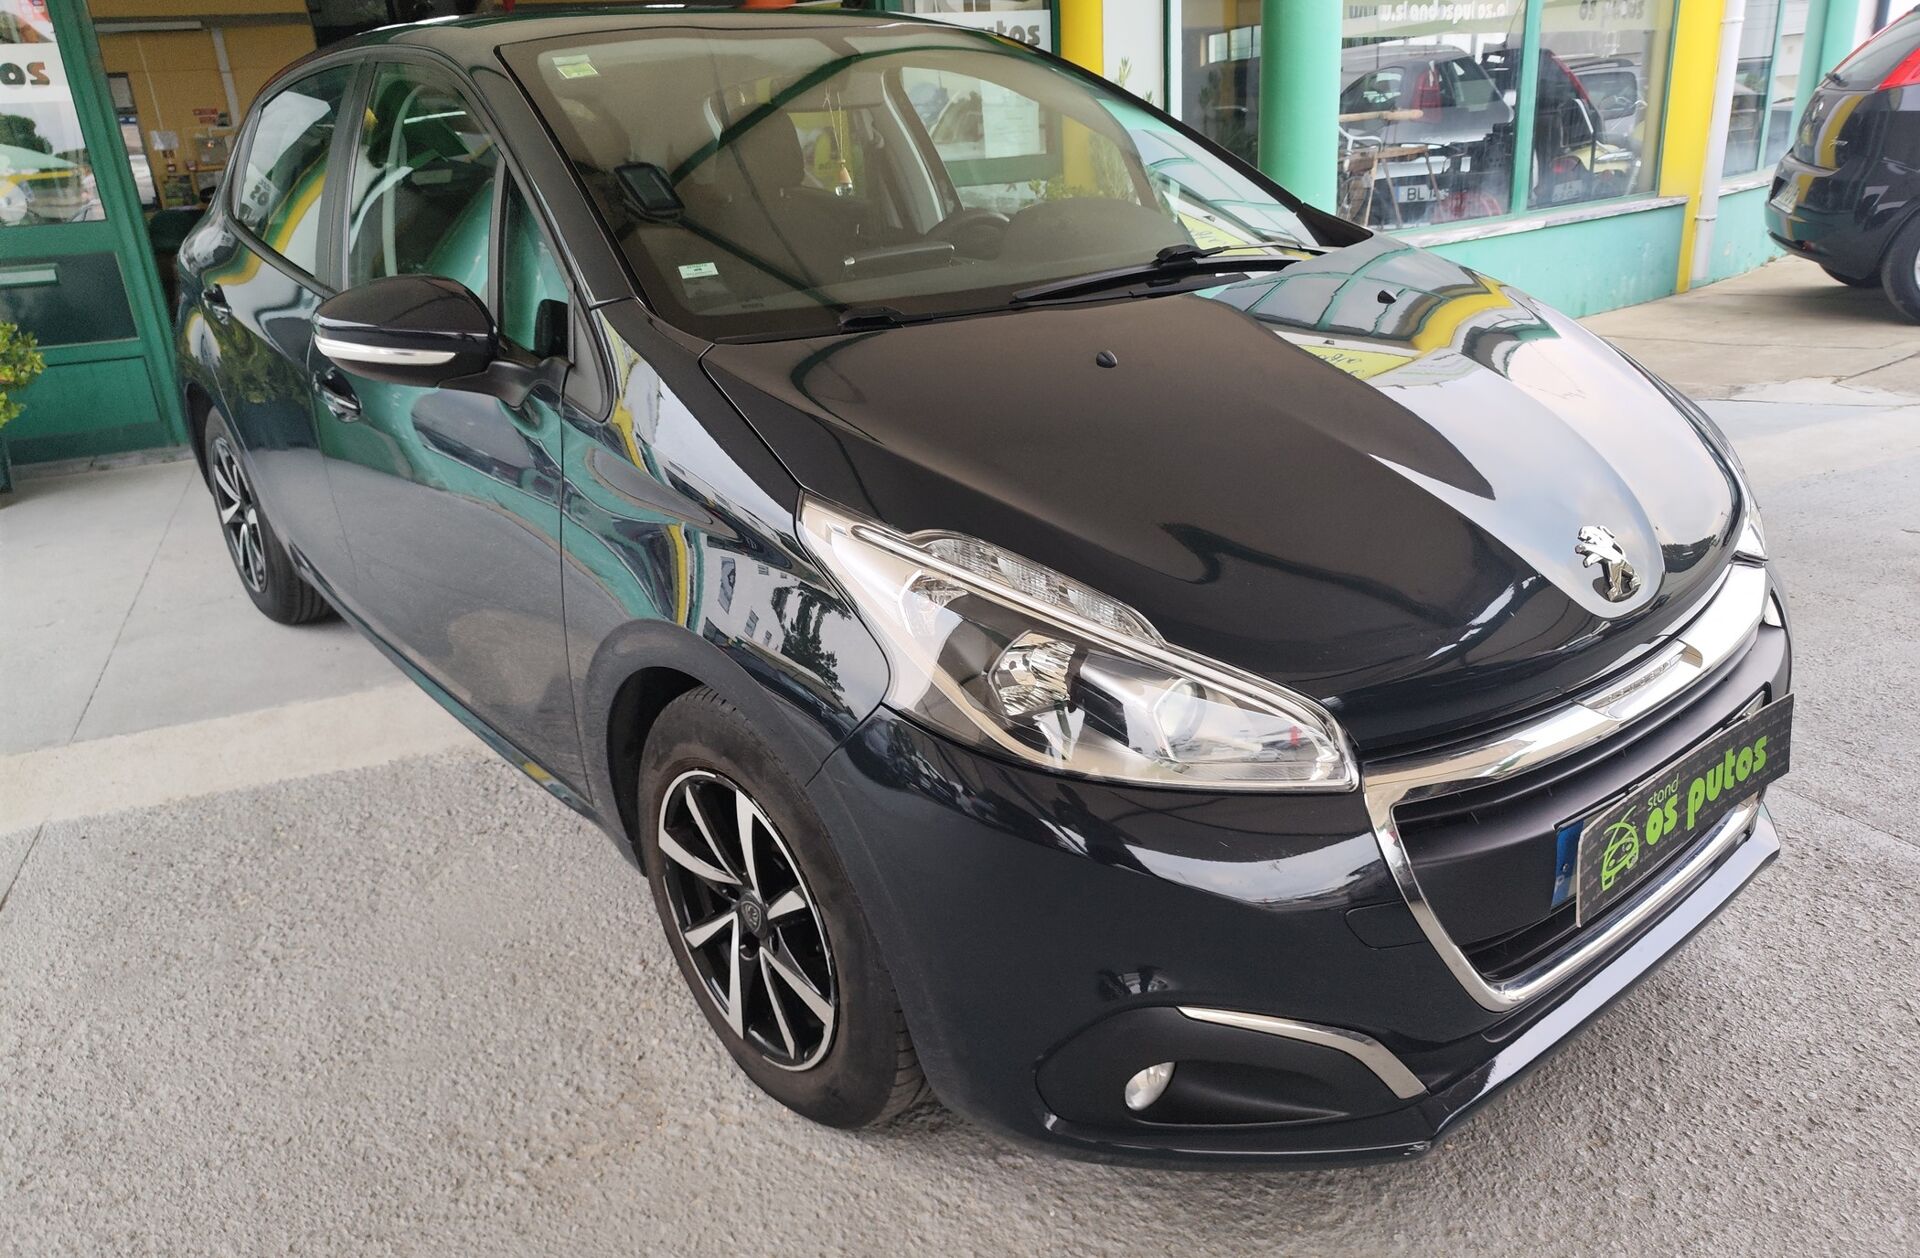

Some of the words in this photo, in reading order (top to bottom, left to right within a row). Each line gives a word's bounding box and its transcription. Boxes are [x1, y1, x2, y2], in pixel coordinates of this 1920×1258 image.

[977, 19, 1041, 46] tos
[1406, 186, 1425, 202] BL
[1646, 794, 1678, 846] os
[1687, 735, 1767, 831] putos
[1647, 772, 1679, 812] stand
